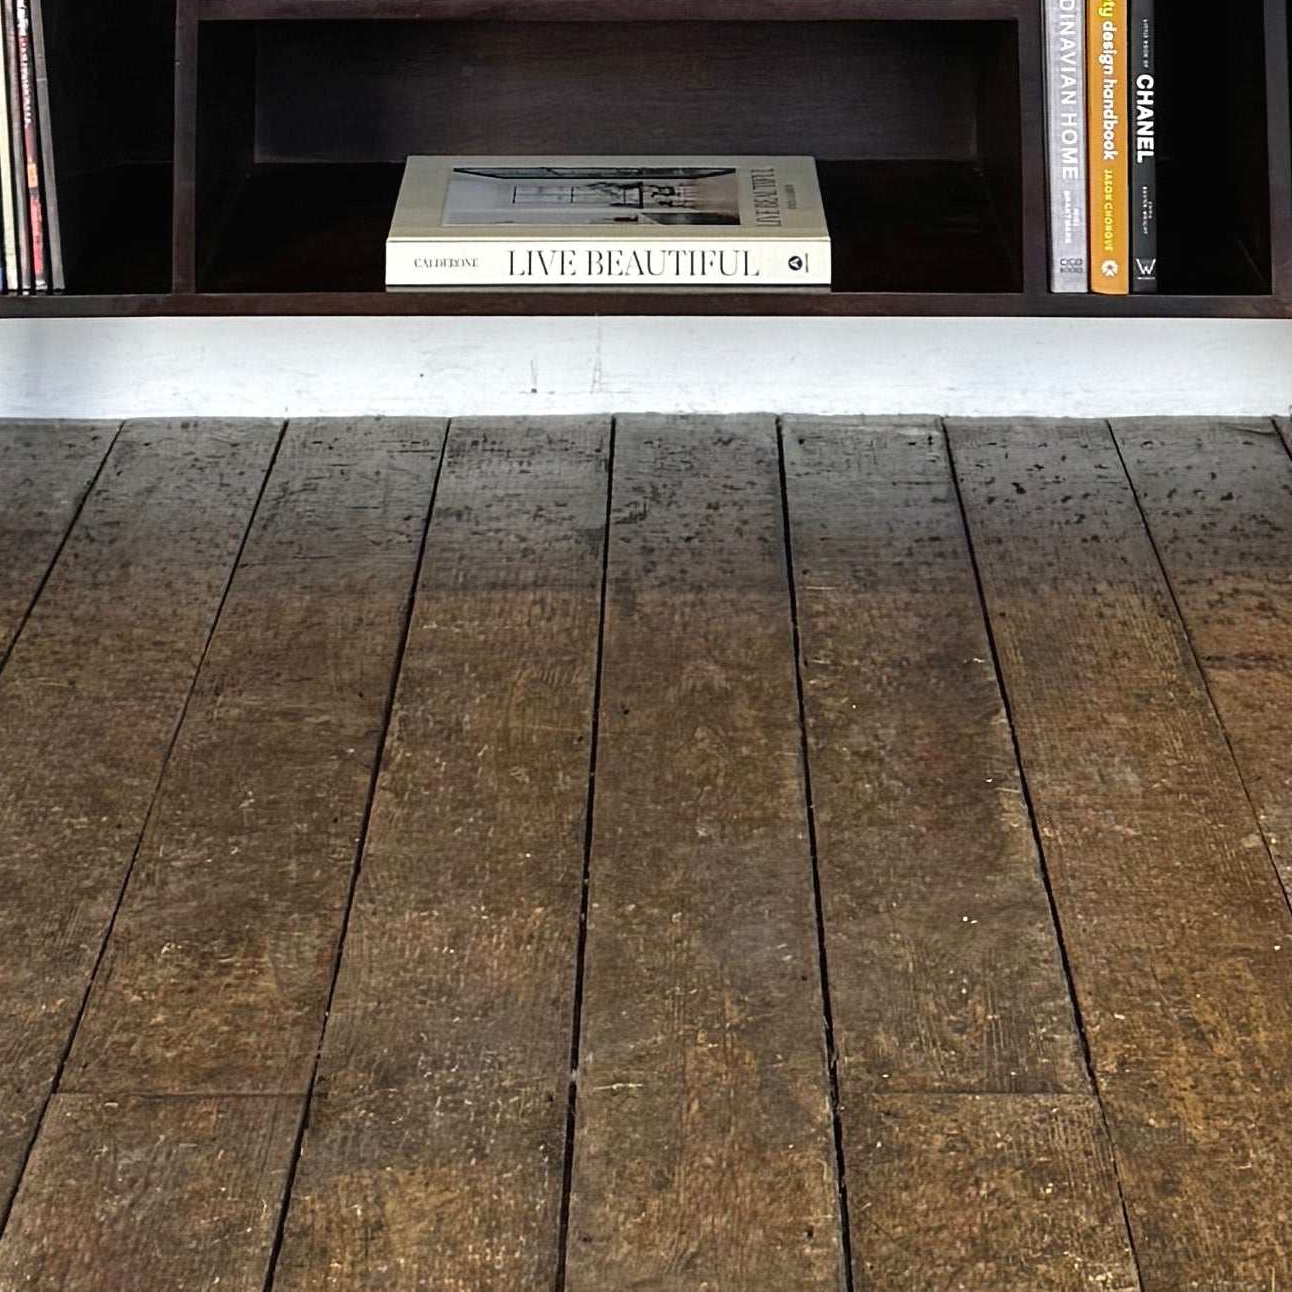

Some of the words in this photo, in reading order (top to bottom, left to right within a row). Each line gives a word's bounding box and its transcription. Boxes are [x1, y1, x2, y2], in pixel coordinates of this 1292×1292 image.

[1099, 20, 1117, 75] design
[1103, 79, 1118, 160] handbook
[1136, 74, 1154, 163] CHANEL
[1061, 113, 1078, 179] HOME
[1104, 169, 1113, 200] JASON
[1104, 202, 1113, 251] CHONGUE
[414, 258, 479, 268] CALDERONE
[507, 250, 577, 276] LIVE
[586, 250, 760, 276] BEAUTIFUL
